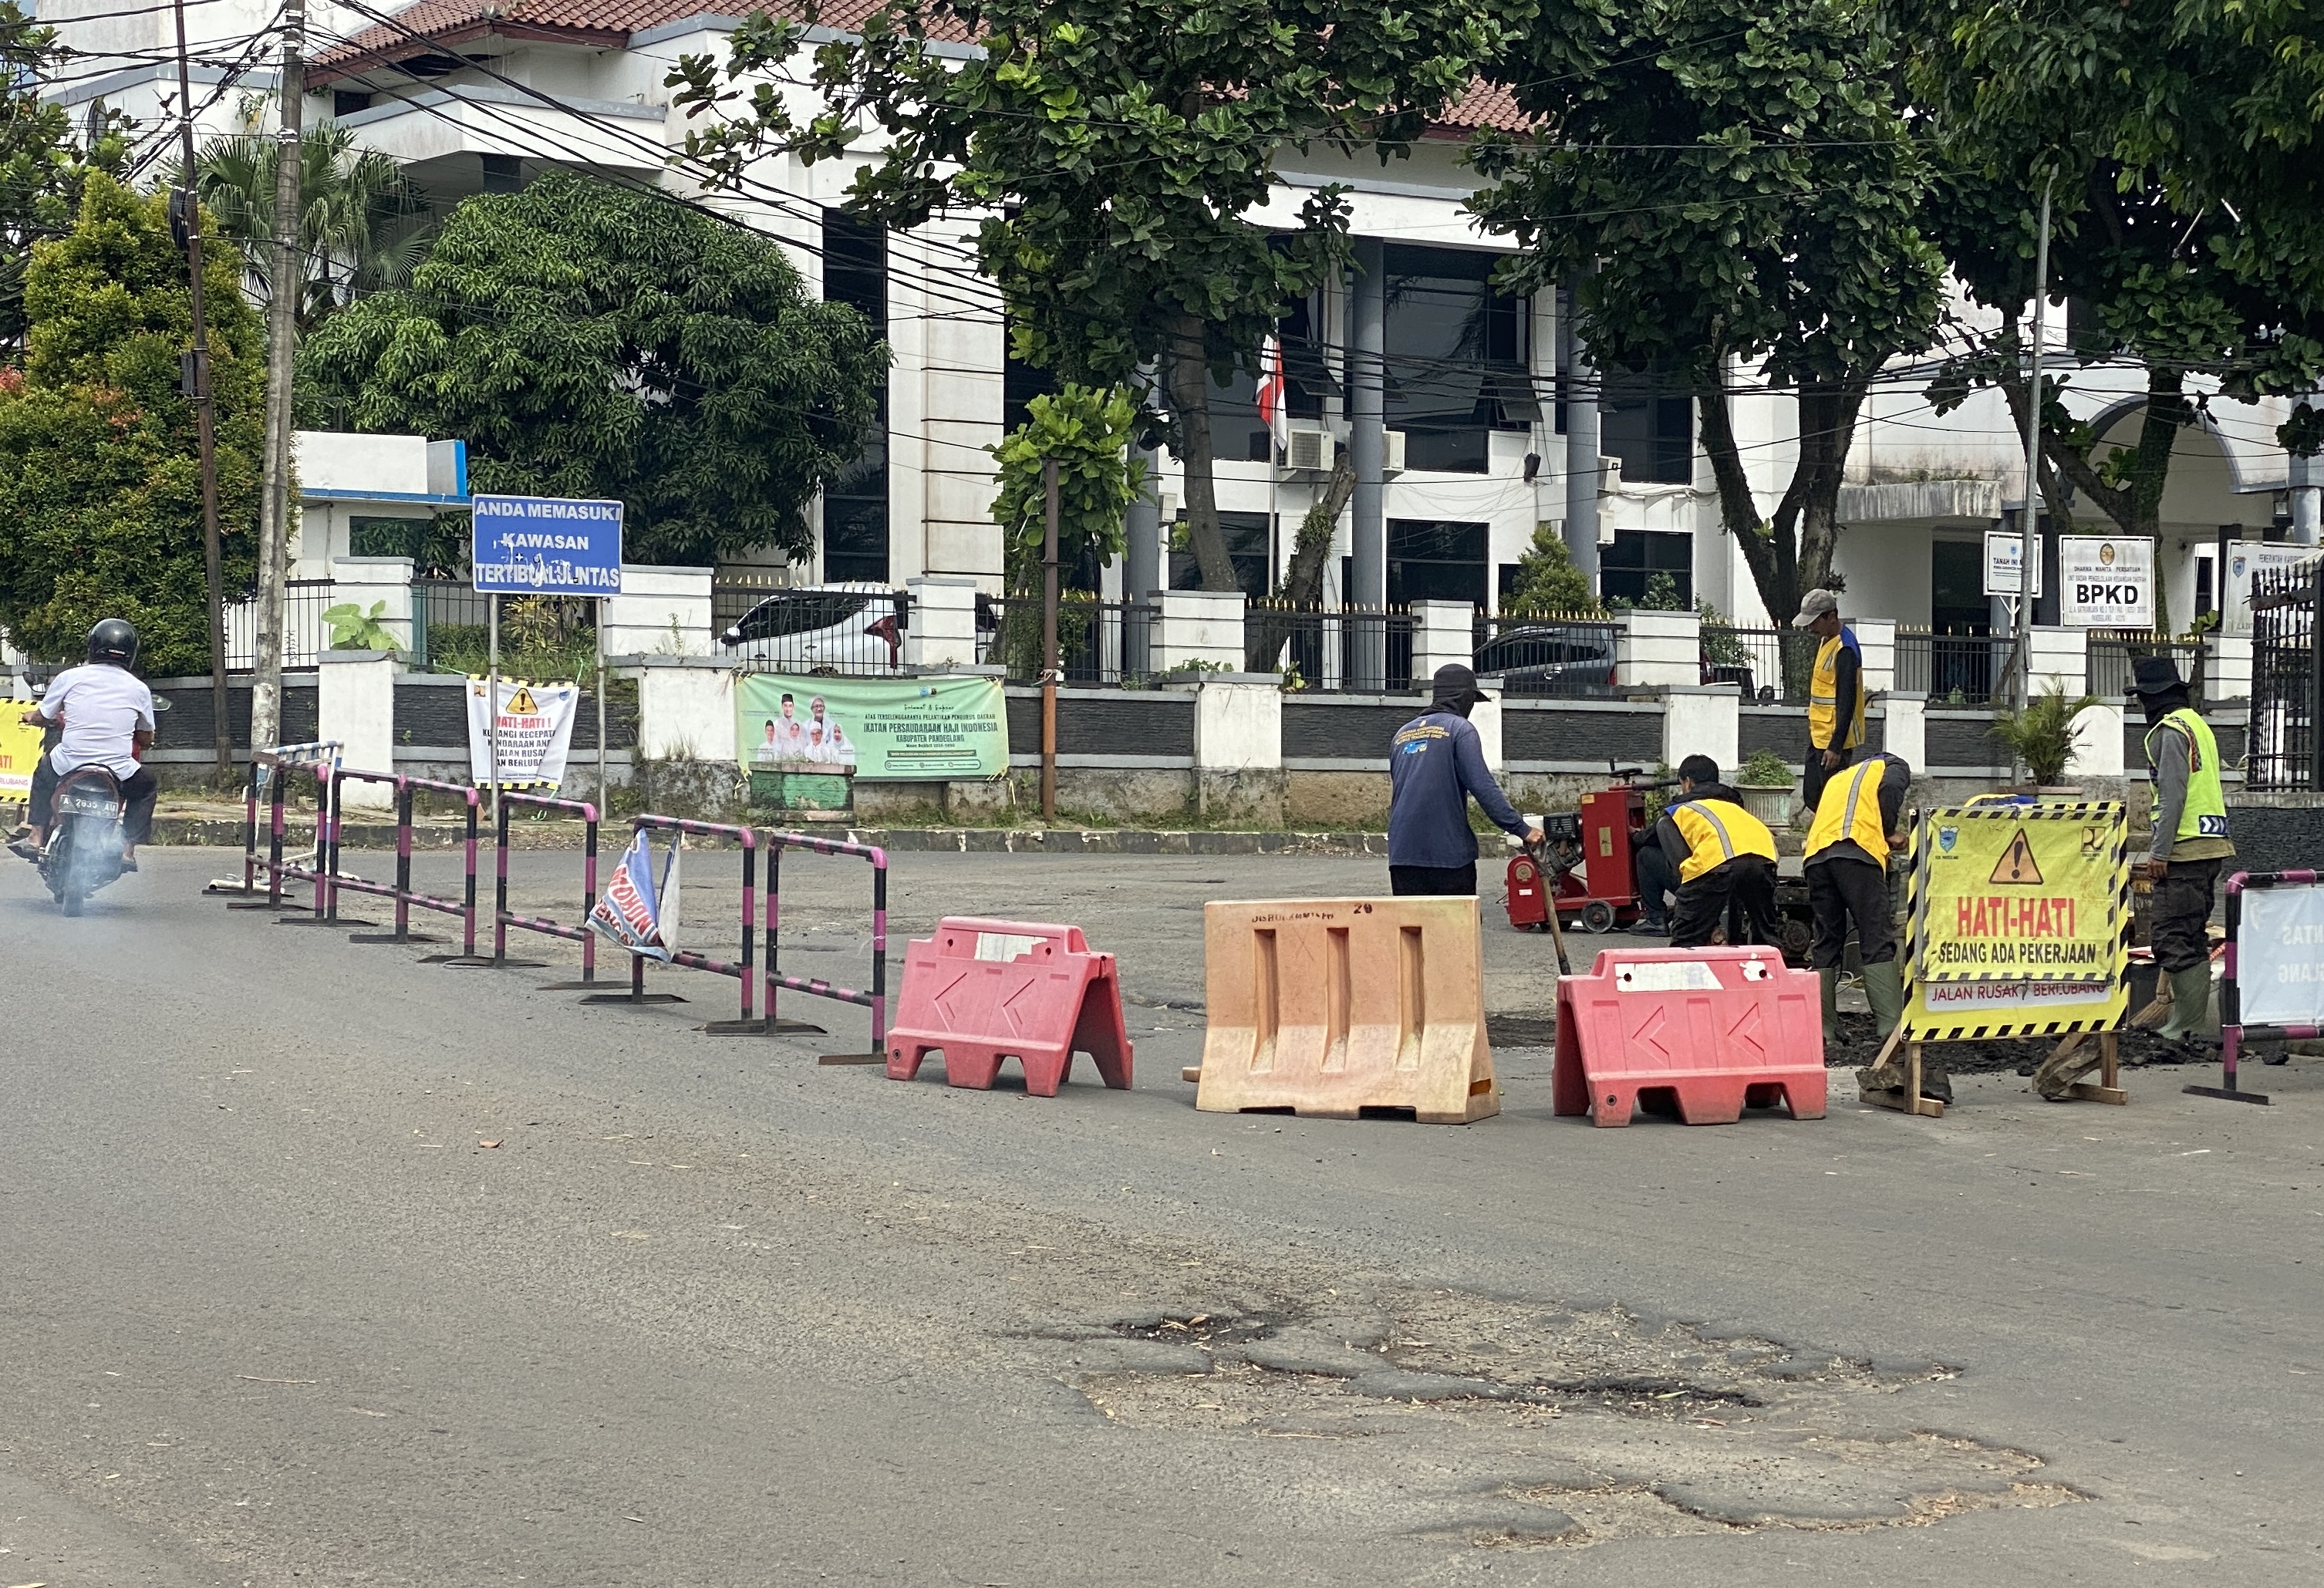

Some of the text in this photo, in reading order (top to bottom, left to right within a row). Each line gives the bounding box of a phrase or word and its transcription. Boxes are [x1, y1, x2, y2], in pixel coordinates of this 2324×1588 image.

[476, 501, 620, 521] ANDA MEMASUKI
[502, 533, 589, 550] KAWASAN
[2076, 584, 2138, 605] BPKD
[483, 729, 517, 738] KUANGI
[864, 723, 998, 733] IKATAN PERSAUDARAAN HAJI INDONESIA
[487, 739, 534, 747] KNDARAAN
[1957, 896, 2075, 937] HATI-HATI
[1938, 942, 2096, 963] SEDANG ADA PEKERJAAN
[1932, 986, 1972, 1002] JALAN
[1978, 985, 2019, 1000] RUSAK
